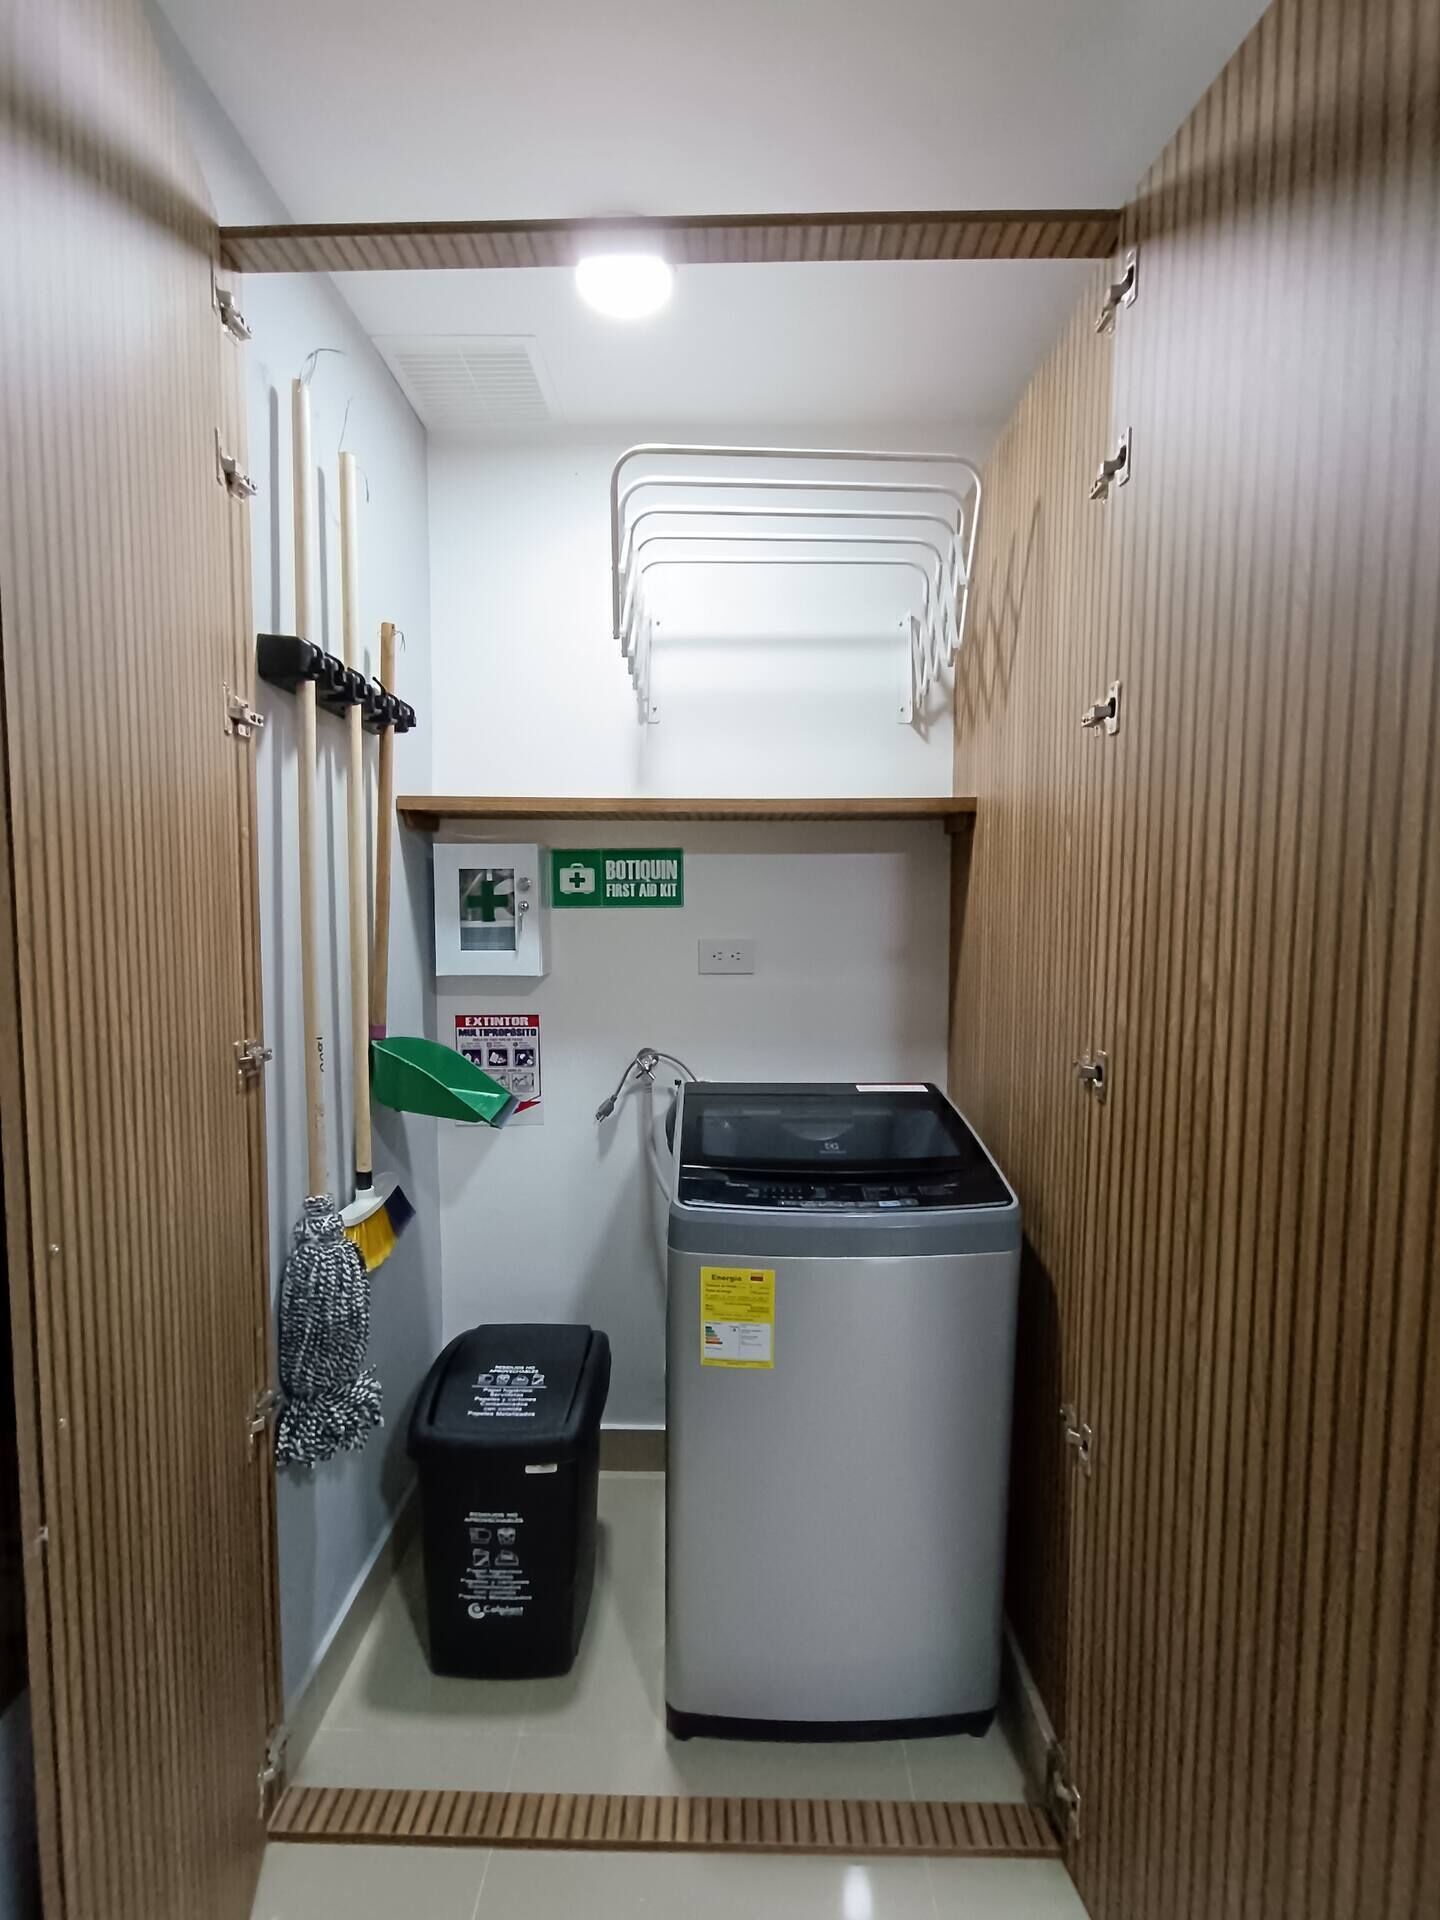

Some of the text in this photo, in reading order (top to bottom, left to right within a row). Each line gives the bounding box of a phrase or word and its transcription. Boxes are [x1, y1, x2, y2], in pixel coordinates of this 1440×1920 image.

[605, 860, 678, 882] BOTIQUIN
[606, 883, 677, 897] FIRST AID KIT
[465, 1016, 529, 1026] EXTINTOR
